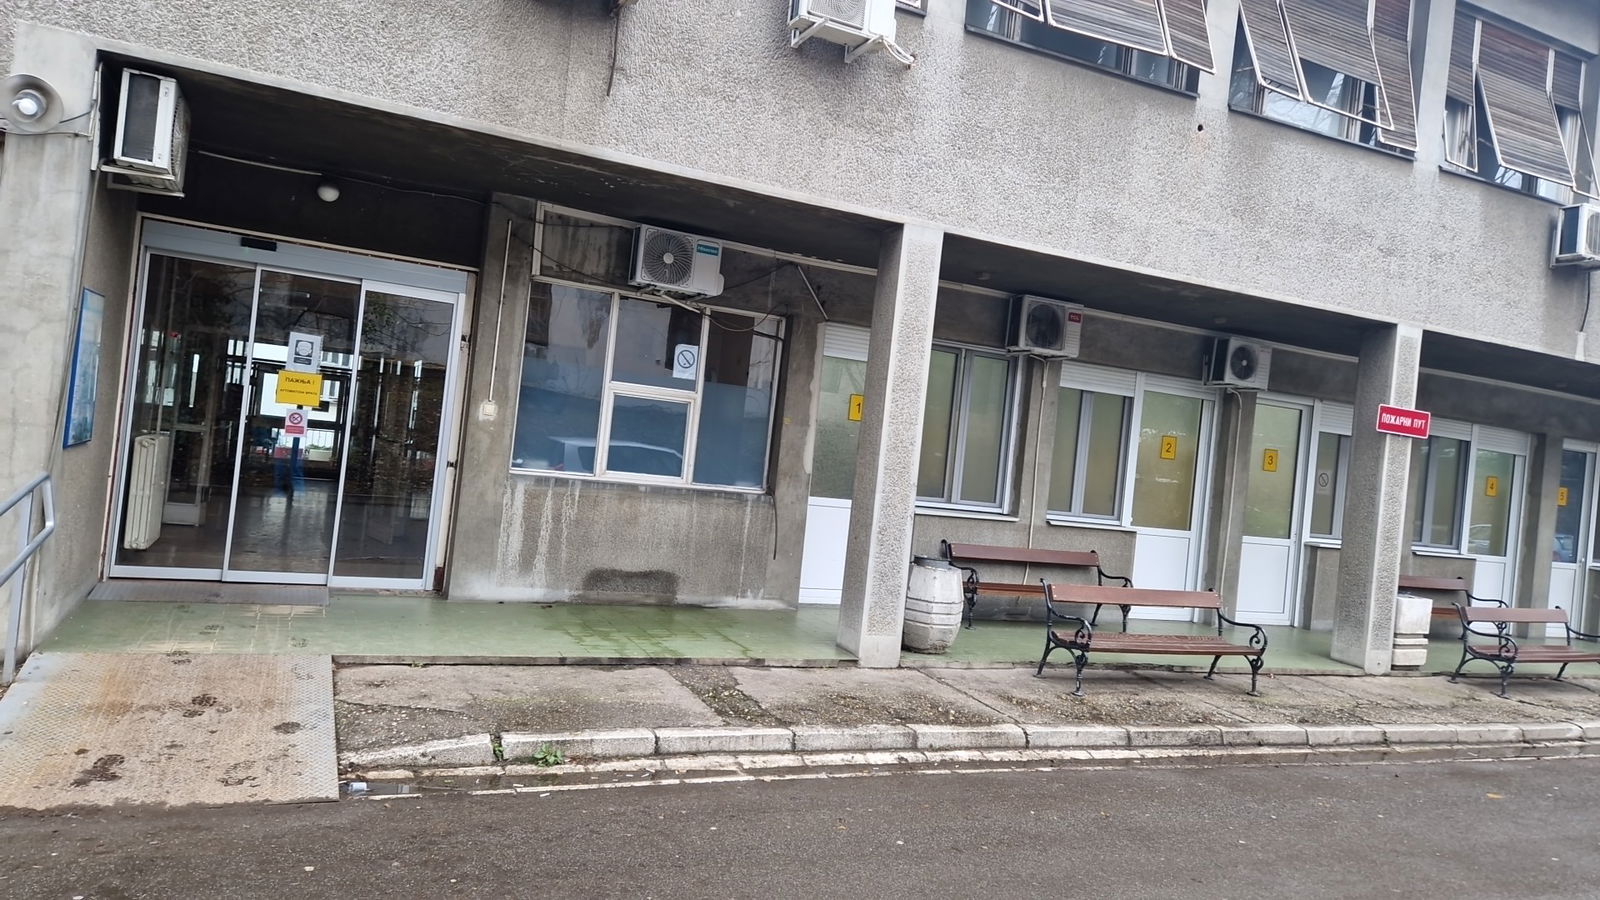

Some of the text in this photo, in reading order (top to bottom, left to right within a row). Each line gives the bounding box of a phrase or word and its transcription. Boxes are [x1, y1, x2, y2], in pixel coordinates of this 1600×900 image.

[855, 402, 861, 414] 1
[1381, 412, 1426, 430] ПОЖАРНИ ПУТ
[1165, 442, 1172, 453] 2
[1267, 455, 1274, 466] 3
[1559, 491, 1565, 501] 5
